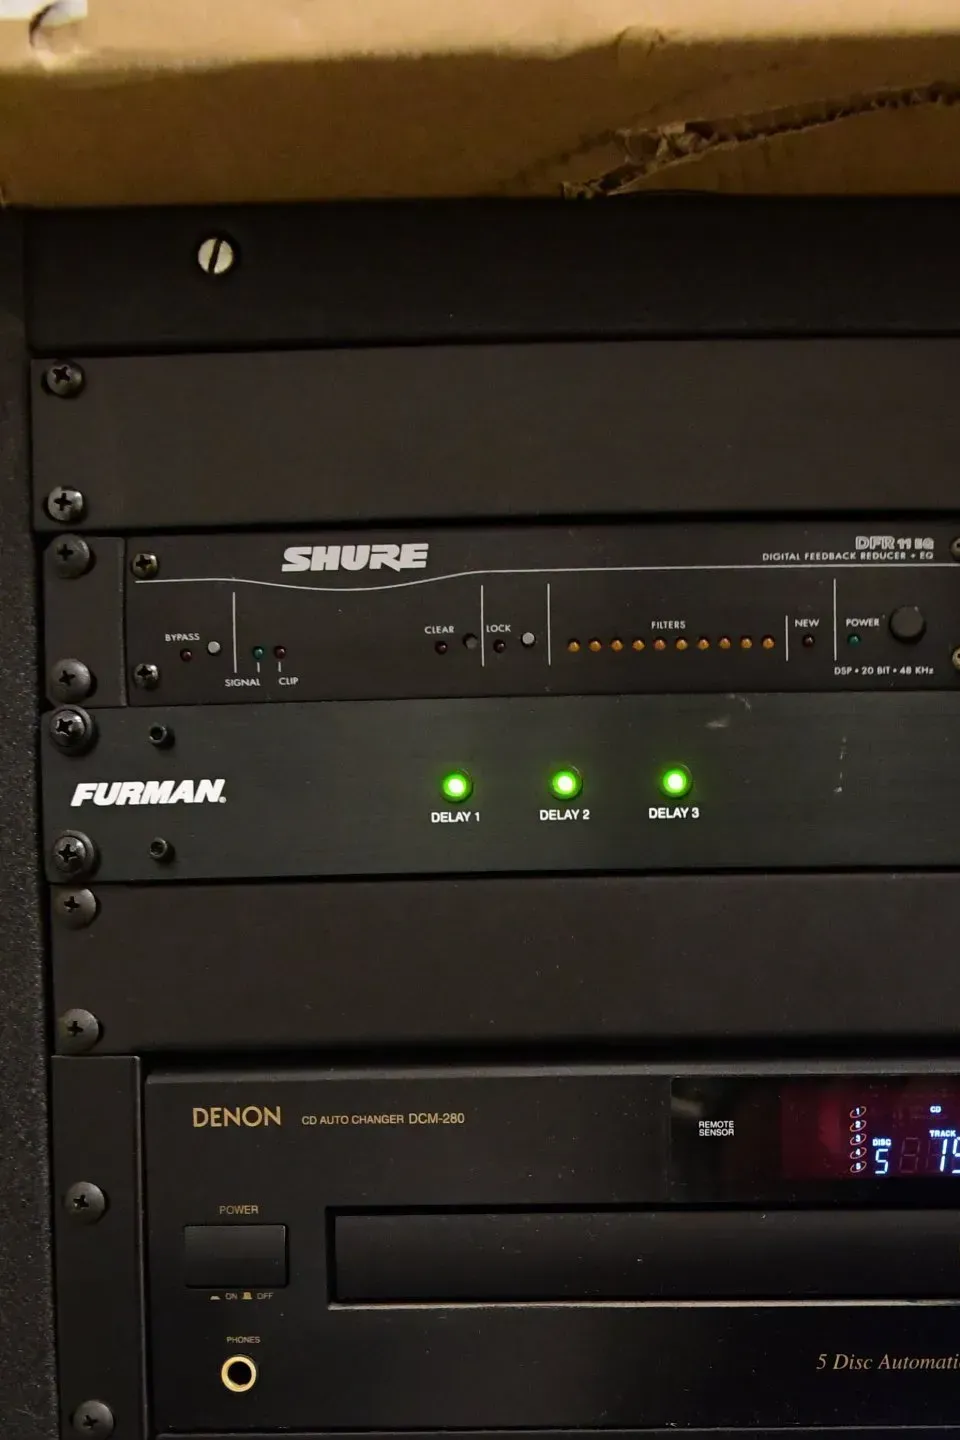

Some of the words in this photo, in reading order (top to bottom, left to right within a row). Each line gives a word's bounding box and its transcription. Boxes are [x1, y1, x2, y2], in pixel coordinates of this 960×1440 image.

[281, 543, 429, 573] SHURE
[762, 553, 800, 562] DIGITAL
[804, 552, 856, 562] FEEDBACK
[860, 552, 907, 561] REDUCER
[919, 552, 934, 561] EQ
[651, 620, 686, 630] FILTERS
[794, 619, 820, 628] NEW
[845, 618, 880, 628] POWER
[424, 625, 454, 635] CLEAR
[486, 623, 512, 634] LOCK
[165, 632, 201, 642] BYPASS
[834, 667, 852, 676] DSP
[224, 678, 260, 687] SIGNAL
[278, 676, 299, 686] CLIP
[431, 812, 471, 823] DELAY
[474, 811, 481, 822] 1
[539, 809, 580, 821] DELAY
[582, 809, 591, 821] 2
[648, 807, 688, 819] DELAY
[691, 807, 700, 818] 3
[192, 1105, 281, 1128] DENON
[301, 1115, 317, 1125] CD
[319, 1115, 349, 1125] AUTO
[351, 1114, 404, 1124] CHANGER
[408, 1112, 465, 1124] DCM-280
[698, 1120, 734, 1128] REMOTE
[698, 1128, 735, 1137] SENSOR
[929, 1130, 957, 1138] TRACK
[872, 1138, 892, 1146] DISC
[874, 1147, 889, 1174] 5
[218, 1205, 259, 1215] POWER
[226, 1336, 261, 1345] PHONES
[816, 1353, 828, 1370] 5
[832, 1353, 873, 1370] Disc
